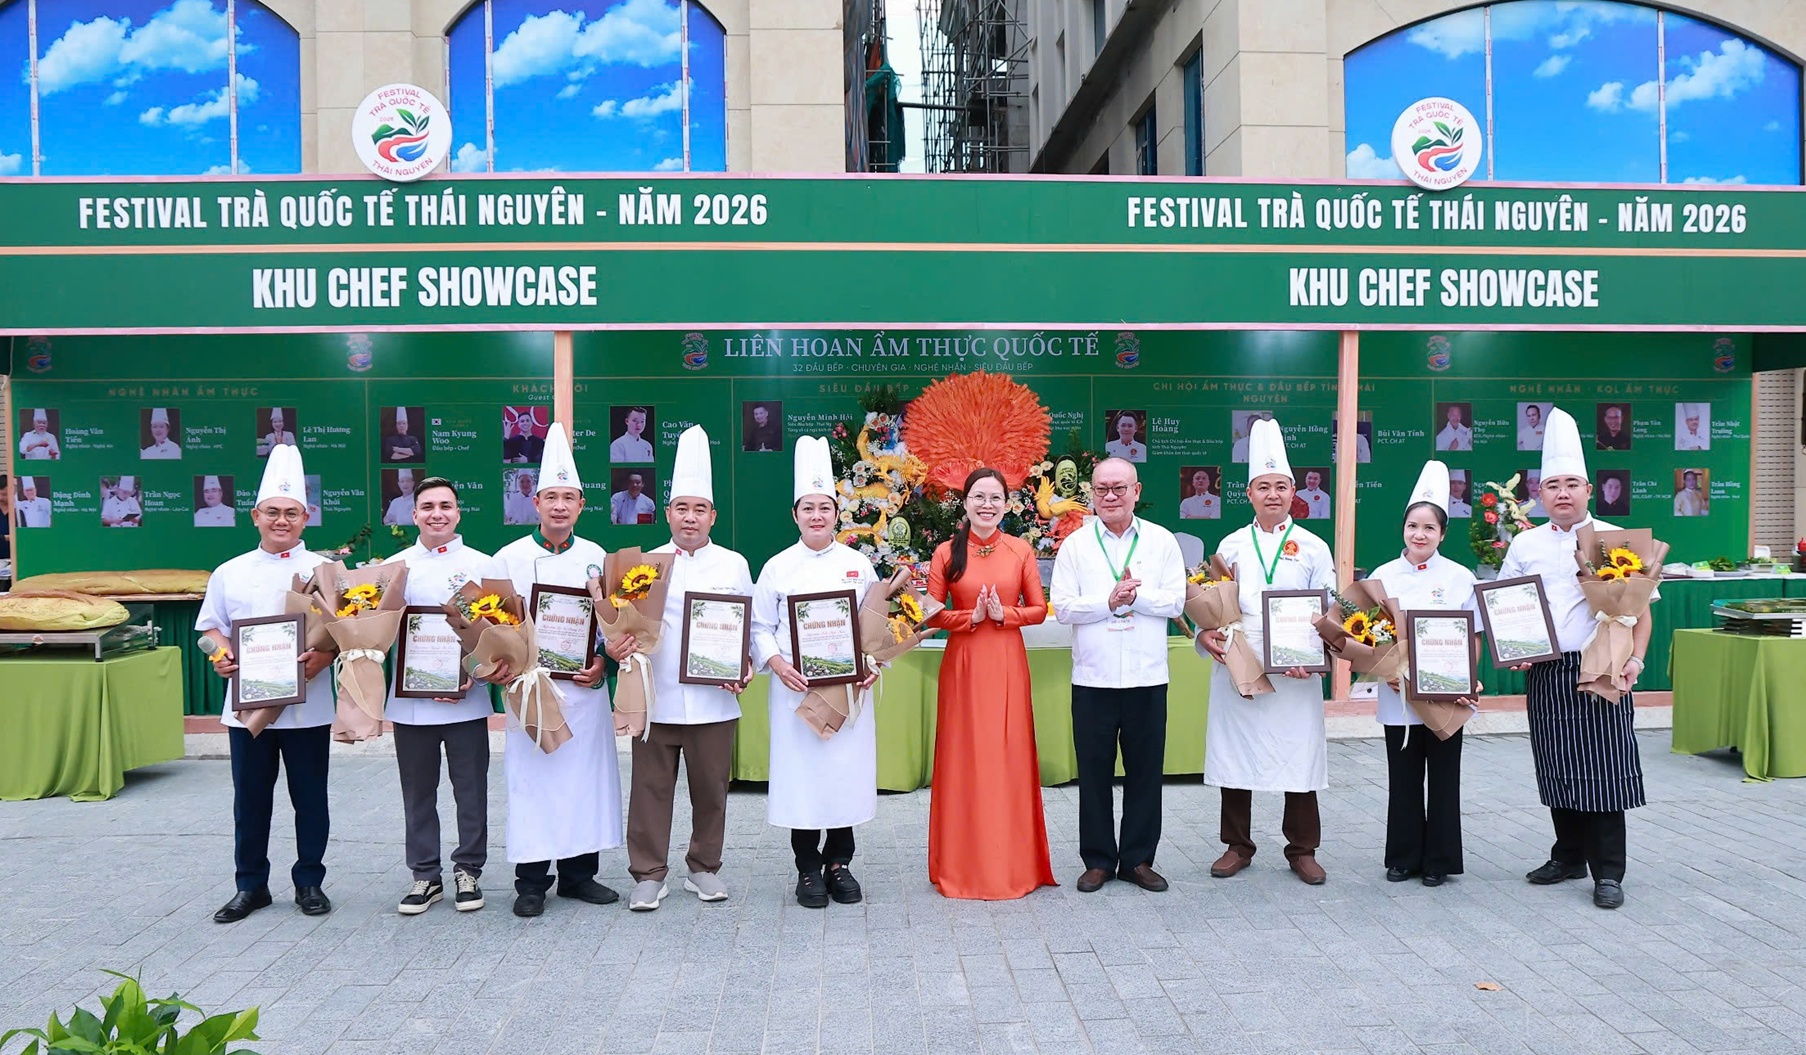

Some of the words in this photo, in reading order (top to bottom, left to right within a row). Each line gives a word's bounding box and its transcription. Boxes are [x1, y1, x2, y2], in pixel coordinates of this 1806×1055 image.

[378, 88, 421, 99] FESTIVAL
[1416, 102, 1454, 113] FESTIVAL
[79, 197, 207, 229] FESTIVAL
[217, 189, 269, 228] TRÀ
[280, 188, 353, 230] QUỐC
[363, 188, 398, 227] TẾ
[405, 187, 466, 226] THÁI
[479, 186, 584, 226] NGUYÊN
[619, 186, 682, 225] NĂM
[693, 194, 768, 225] 2026
[1128, 197, 1247, 228] FESTIVAL
[1257, 190, 1305, 229] TRÀ
[1316, 192, 1382, 231] QUỐC
[1392, 193, 1424, 230] TẾ
[1430, 193, 1484, 230] THÁI
[1494, 194, 1588, 232] NGUYÊN
[1618, 196, 1672, 233] NĂM
[1682, 203, 1746, 233] 2026
[253, 268, 316, 309] KHU
[328, 267, 407, 308] CHEF
[418, 266, 597, 307] SHOWCASE
[1289, 268, 1348, 306] KHU
[1358, 268, 1431, 307] CHEF
[1440, 269, 1599, 307] SHOWCASE
[724, 334, 784, 357] LIÊN
[791, 338, 863, 357] HOAN
[870, 331, 910, 357] ẨM
[916, 335, 986, 361] THỰC
[993, 331, 1062, 361] QUỐC
[1068, 331, 1099, 356] TẾ
[793, 364, 803, 372] 32
[827, 361, 844, 372] BẾP
[851, 363, 887, 371] CHUYÊN
[914, 364, 939, 372] NGHỆ
[942, 362, 966, 371] NHÂN
[974, 362, 993, 371] SIÊU
[1017, 361, 1033, 371] BẾP
[152, 386, 189, 396] NHÂN
[223, 387, 259, 397] THỰC
[819, 383, 847, 393] SIÊU
[1177, 382, 1197, 393] HỘI
[1224, 382, 1252, 392] THỰC
[1509, 384, 1542, 395] NGHỆ
[1548, 384, 1581, 393] NHÂN
[1649, 385, 1678, 395] THỰC
[1243, 393, 1288, 403] NGUYÊN
[788, 413, 815, 422] Nguyễn
[1068, 411, 1084, 419] Nghị
[1152, 417, 1162, 425] Lê
[1164, 418, 1180, 426] Huy
[186, 426, 212, 435] Nguyễn
[313, 426, 325, 434] Thị
[327, 426, 351, 434] Hương
[1152, 425, 1179, 433] Hoàng
[452, 430, 477, 439] Kyung
[163, 491, 181, 499] Ngọc
[323, 488, 350, 497] Nguyễn
[1227, 490, 1247, 498] Quỳn
[542, 613, 565, 623] CHỨNG
[803, 620, 826, 630] CHỨNG
[827, 619, 846, 629] NHẬN
